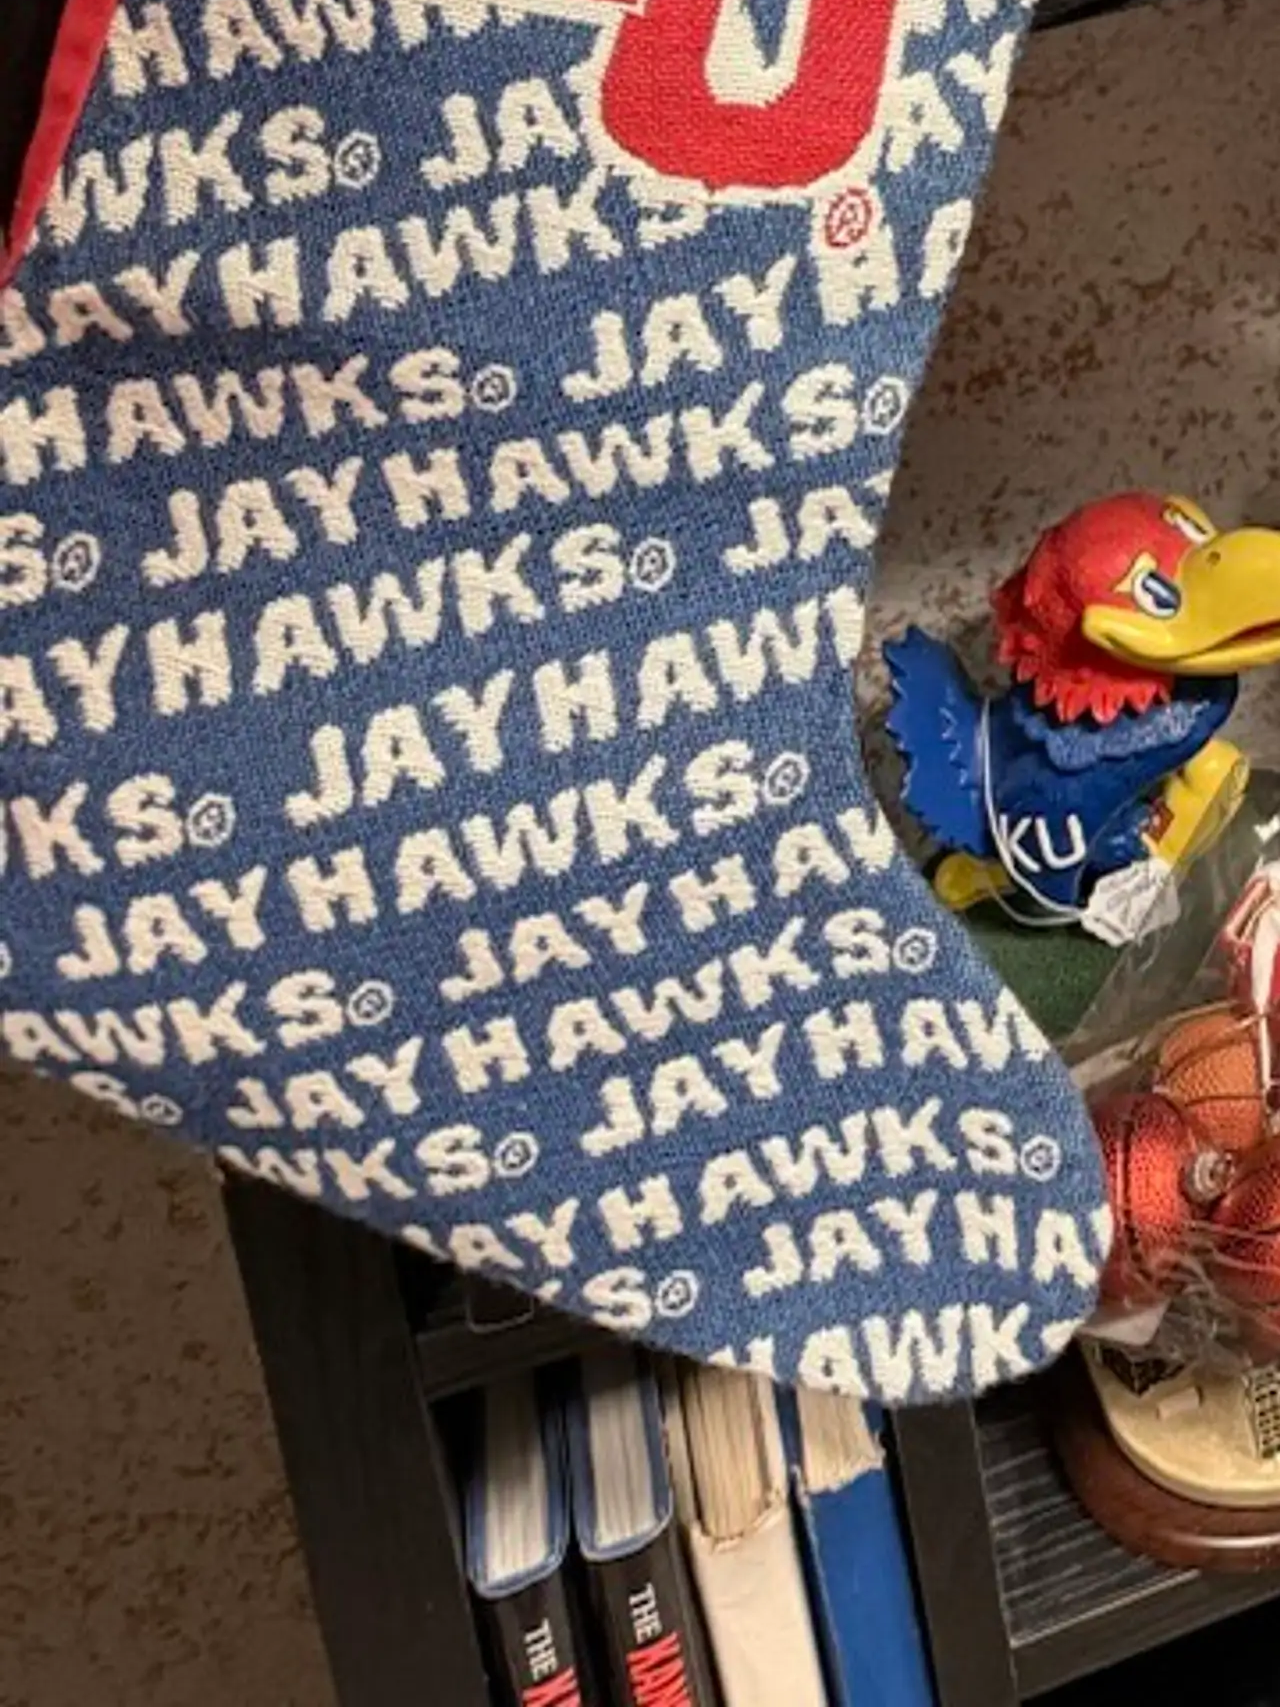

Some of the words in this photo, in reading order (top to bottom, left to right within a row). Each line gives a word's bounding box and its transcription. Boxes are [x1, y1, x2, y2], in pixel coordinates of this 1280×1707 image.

[1000, 813, 1088, 873] KU
[627, 1582, 663, 1645] THE
[524, 1618, 558, 1679] THE
